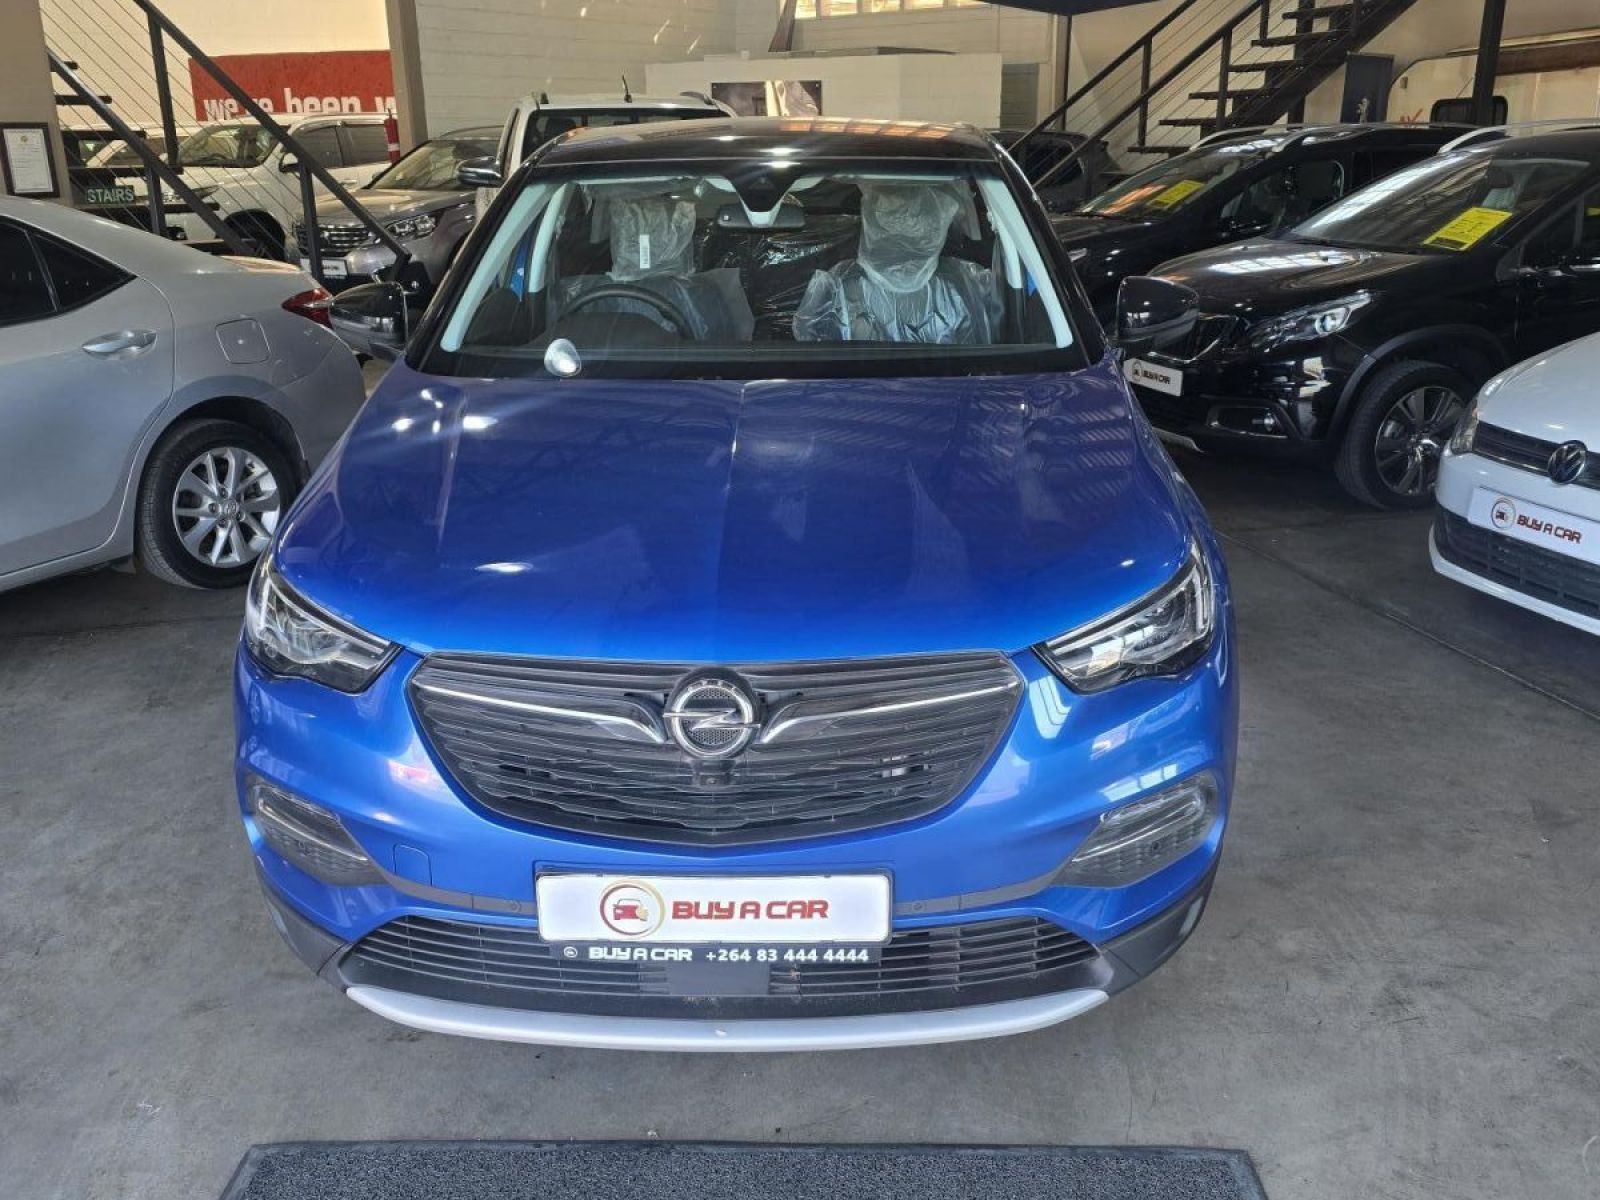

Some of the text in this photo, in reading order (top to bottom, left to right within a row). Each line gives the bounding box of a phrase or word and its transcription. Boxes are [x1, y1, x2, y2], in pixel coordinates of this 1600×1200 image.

[87, 188, 134, 203] STAIRS
[1516, 514, 1583, 544] BUY A CAR
[671, 899, 829, 920] BUY A CAR
[588, 946, 869, 962] BUY A CAR +264 83 444 4444
